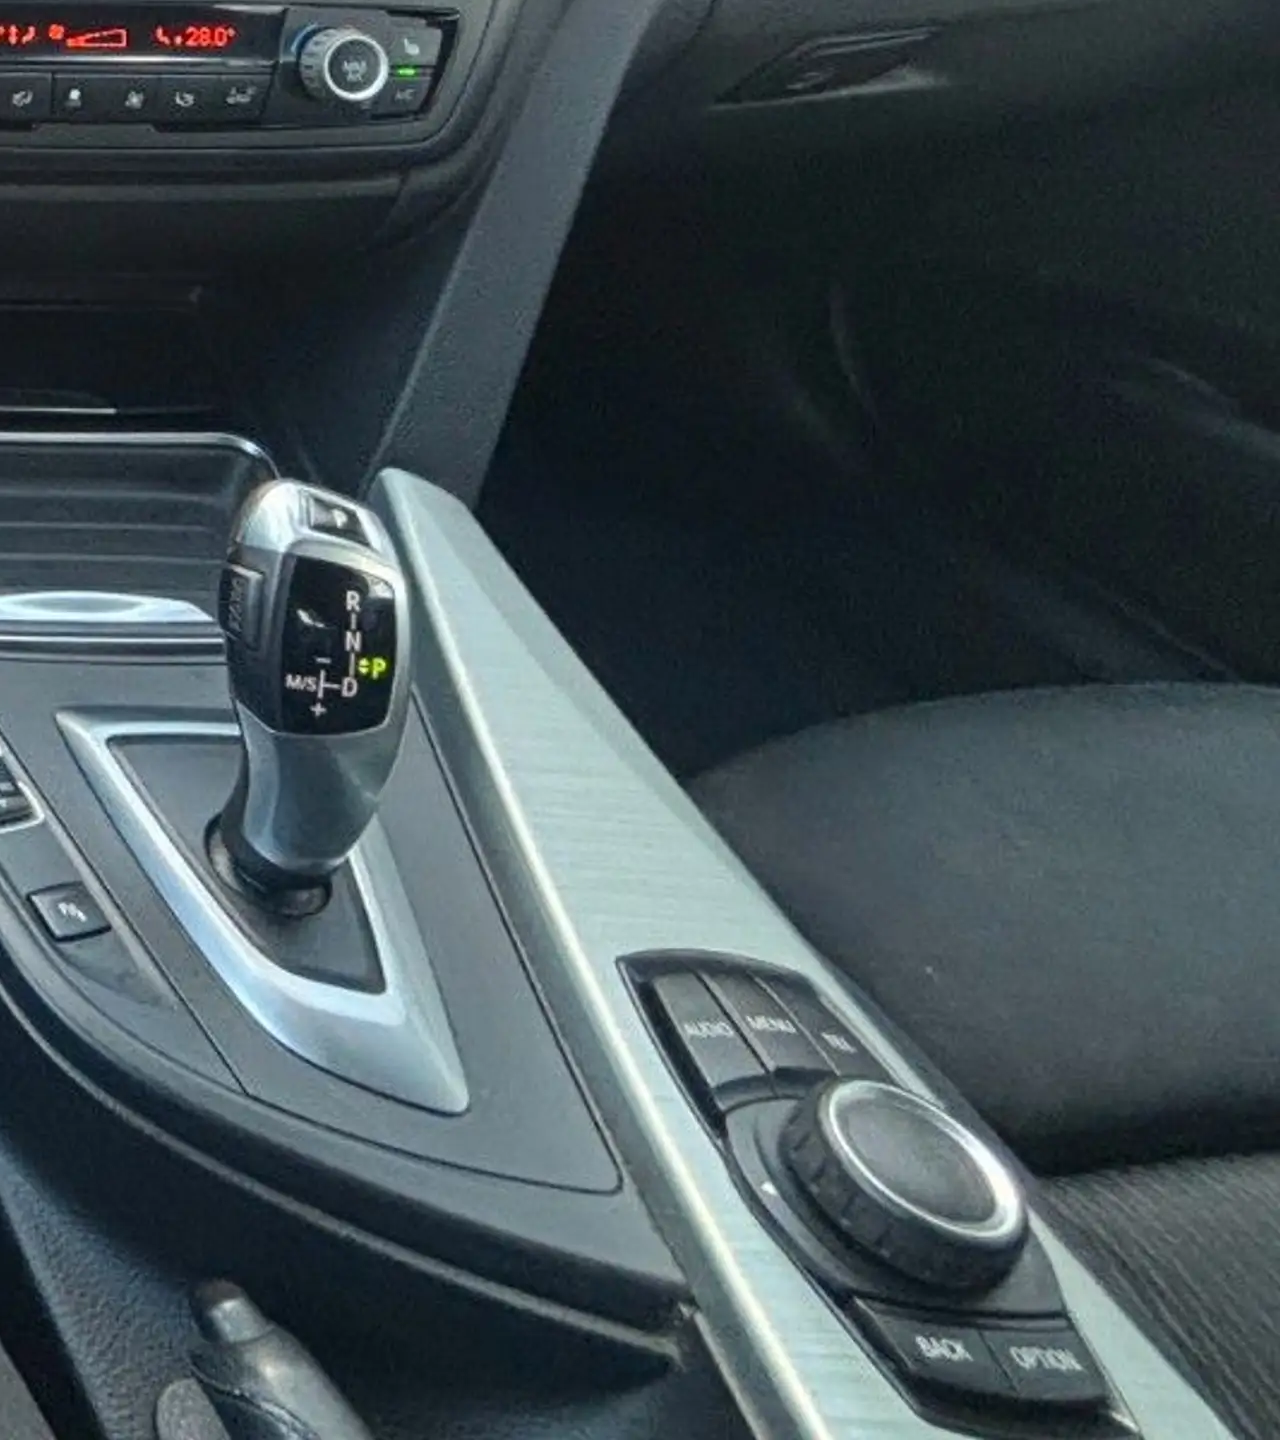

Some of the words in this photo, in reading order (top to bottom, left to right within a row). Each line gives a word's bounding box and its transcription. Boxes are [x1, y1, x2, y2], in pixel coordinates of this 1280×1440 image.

[346, 590, 360, 611] R
[345, 631, 362, 652] N
[372, 659, 386, 679] P
[286, 674, 316, 692] M/S
[342, 677, 357, 697] D
[745, 1015, 797, 1034] MENU
[915, 1335, 974, 1362] BACK
[1009, 1345, 1084, 1372] OPTION
